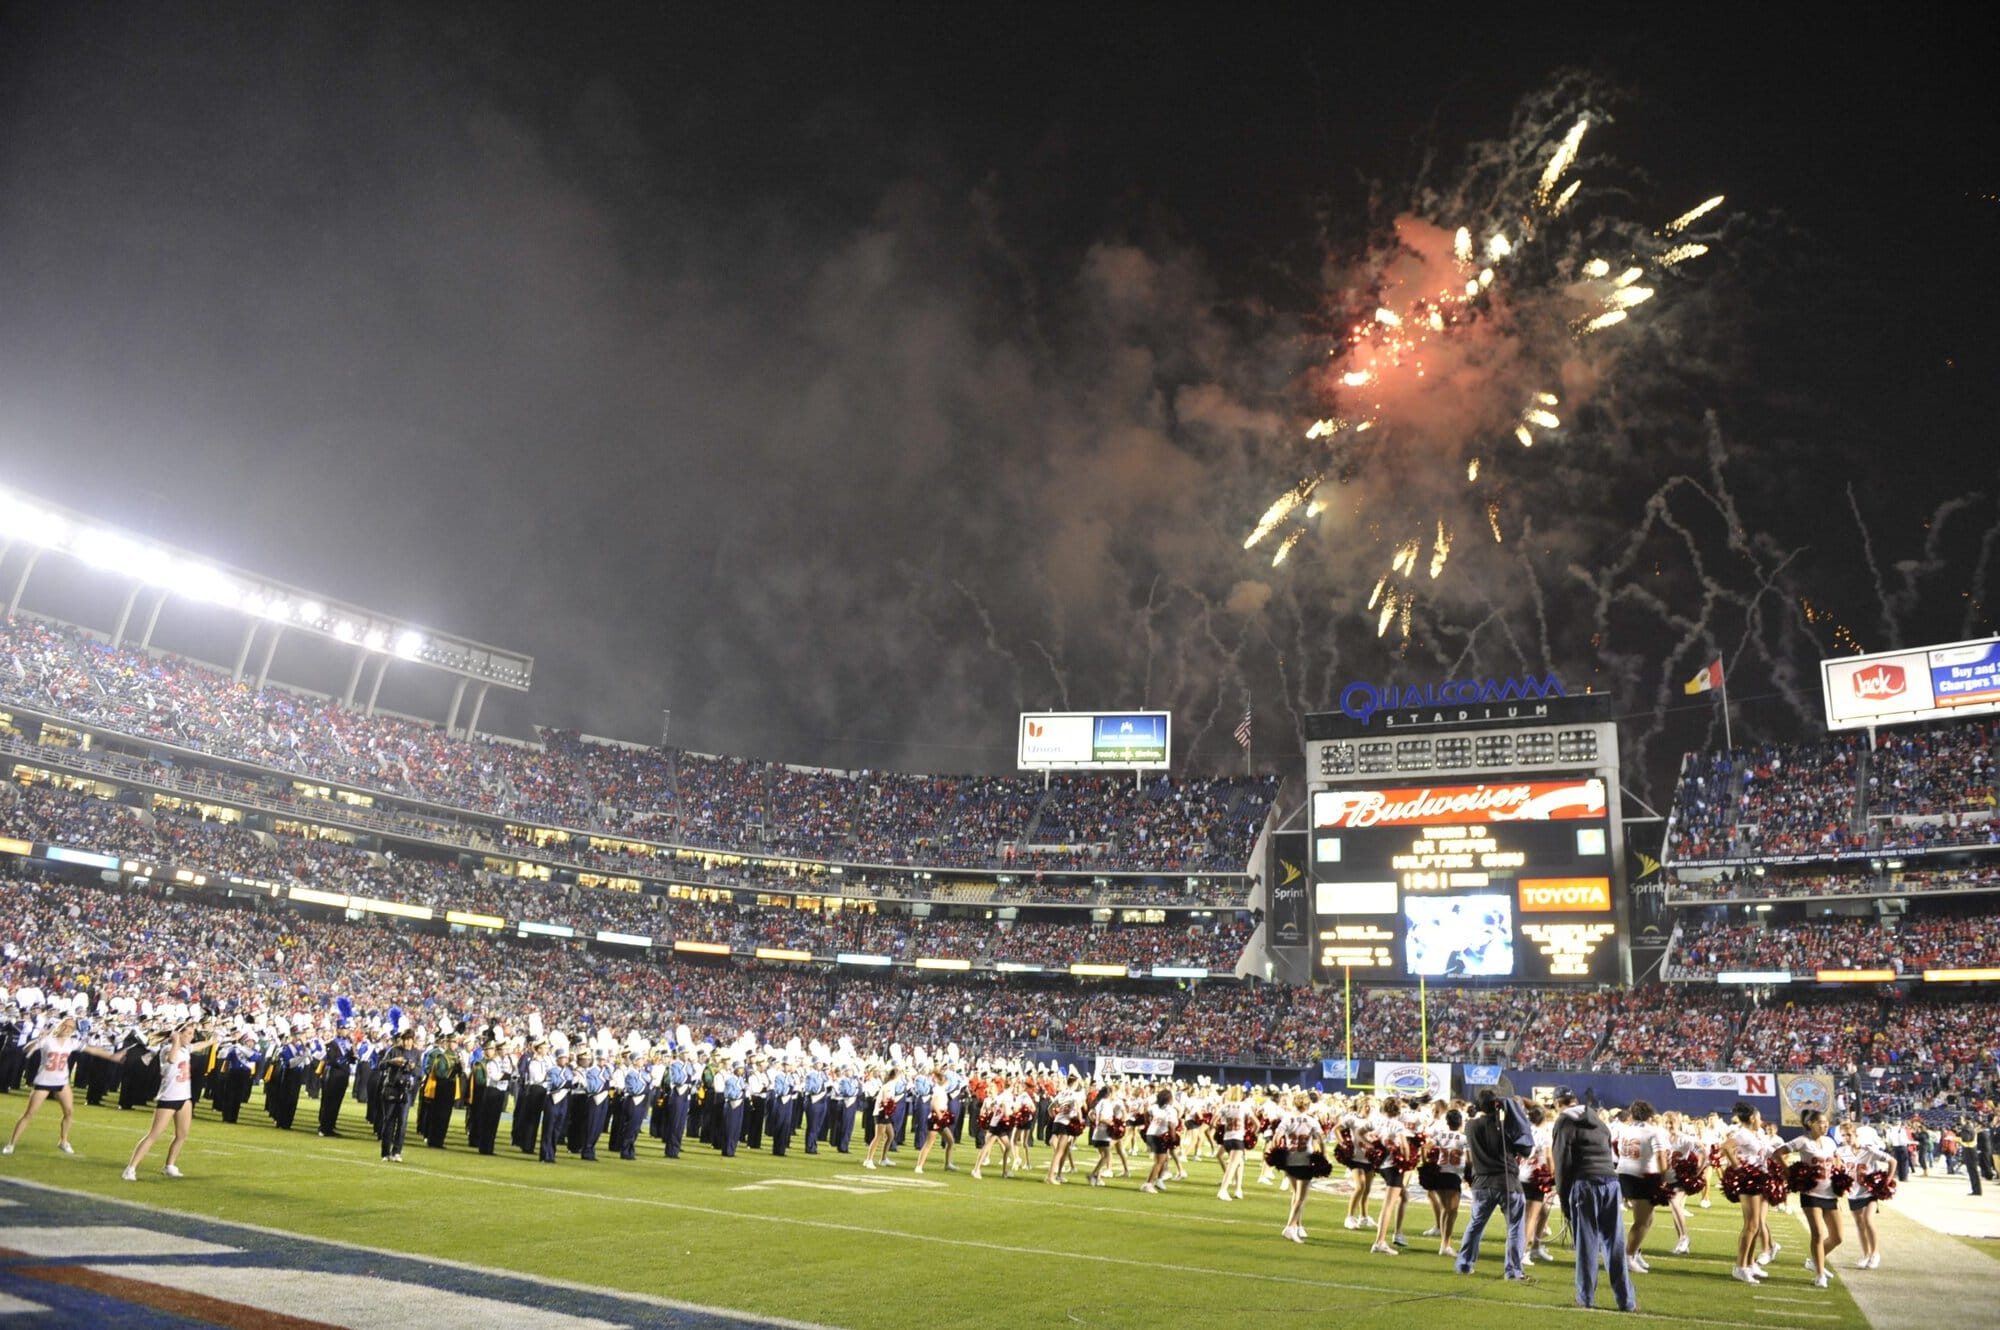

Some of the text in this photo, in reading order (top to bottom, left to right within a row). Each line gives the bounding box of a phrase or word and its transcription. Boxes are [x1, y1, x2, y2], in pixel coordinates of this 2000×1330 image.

[1952, 667, 1972, 679] Buy
[1975, 663, 1995, 675] and
[1855, 667, 1905, 697] Jack
[1939, 677, 1990, 692] Chargers
[1340, 675, 1566, 725] QUALCOMM
[1387, 705, 1547, 725] STADIUM
[1342, 785, 1531, 827] Budweiser
[1274, 888, 1304, 900] Sprint
[1522, 886, 1606, 905] TOYOTA
[1630, 882, 1664, 896] Sprint
[176, 1060, 191, 1083] 3
[1102, 1058, 1116, 1074] A
[1745, 1075, 1767, 1094] N
